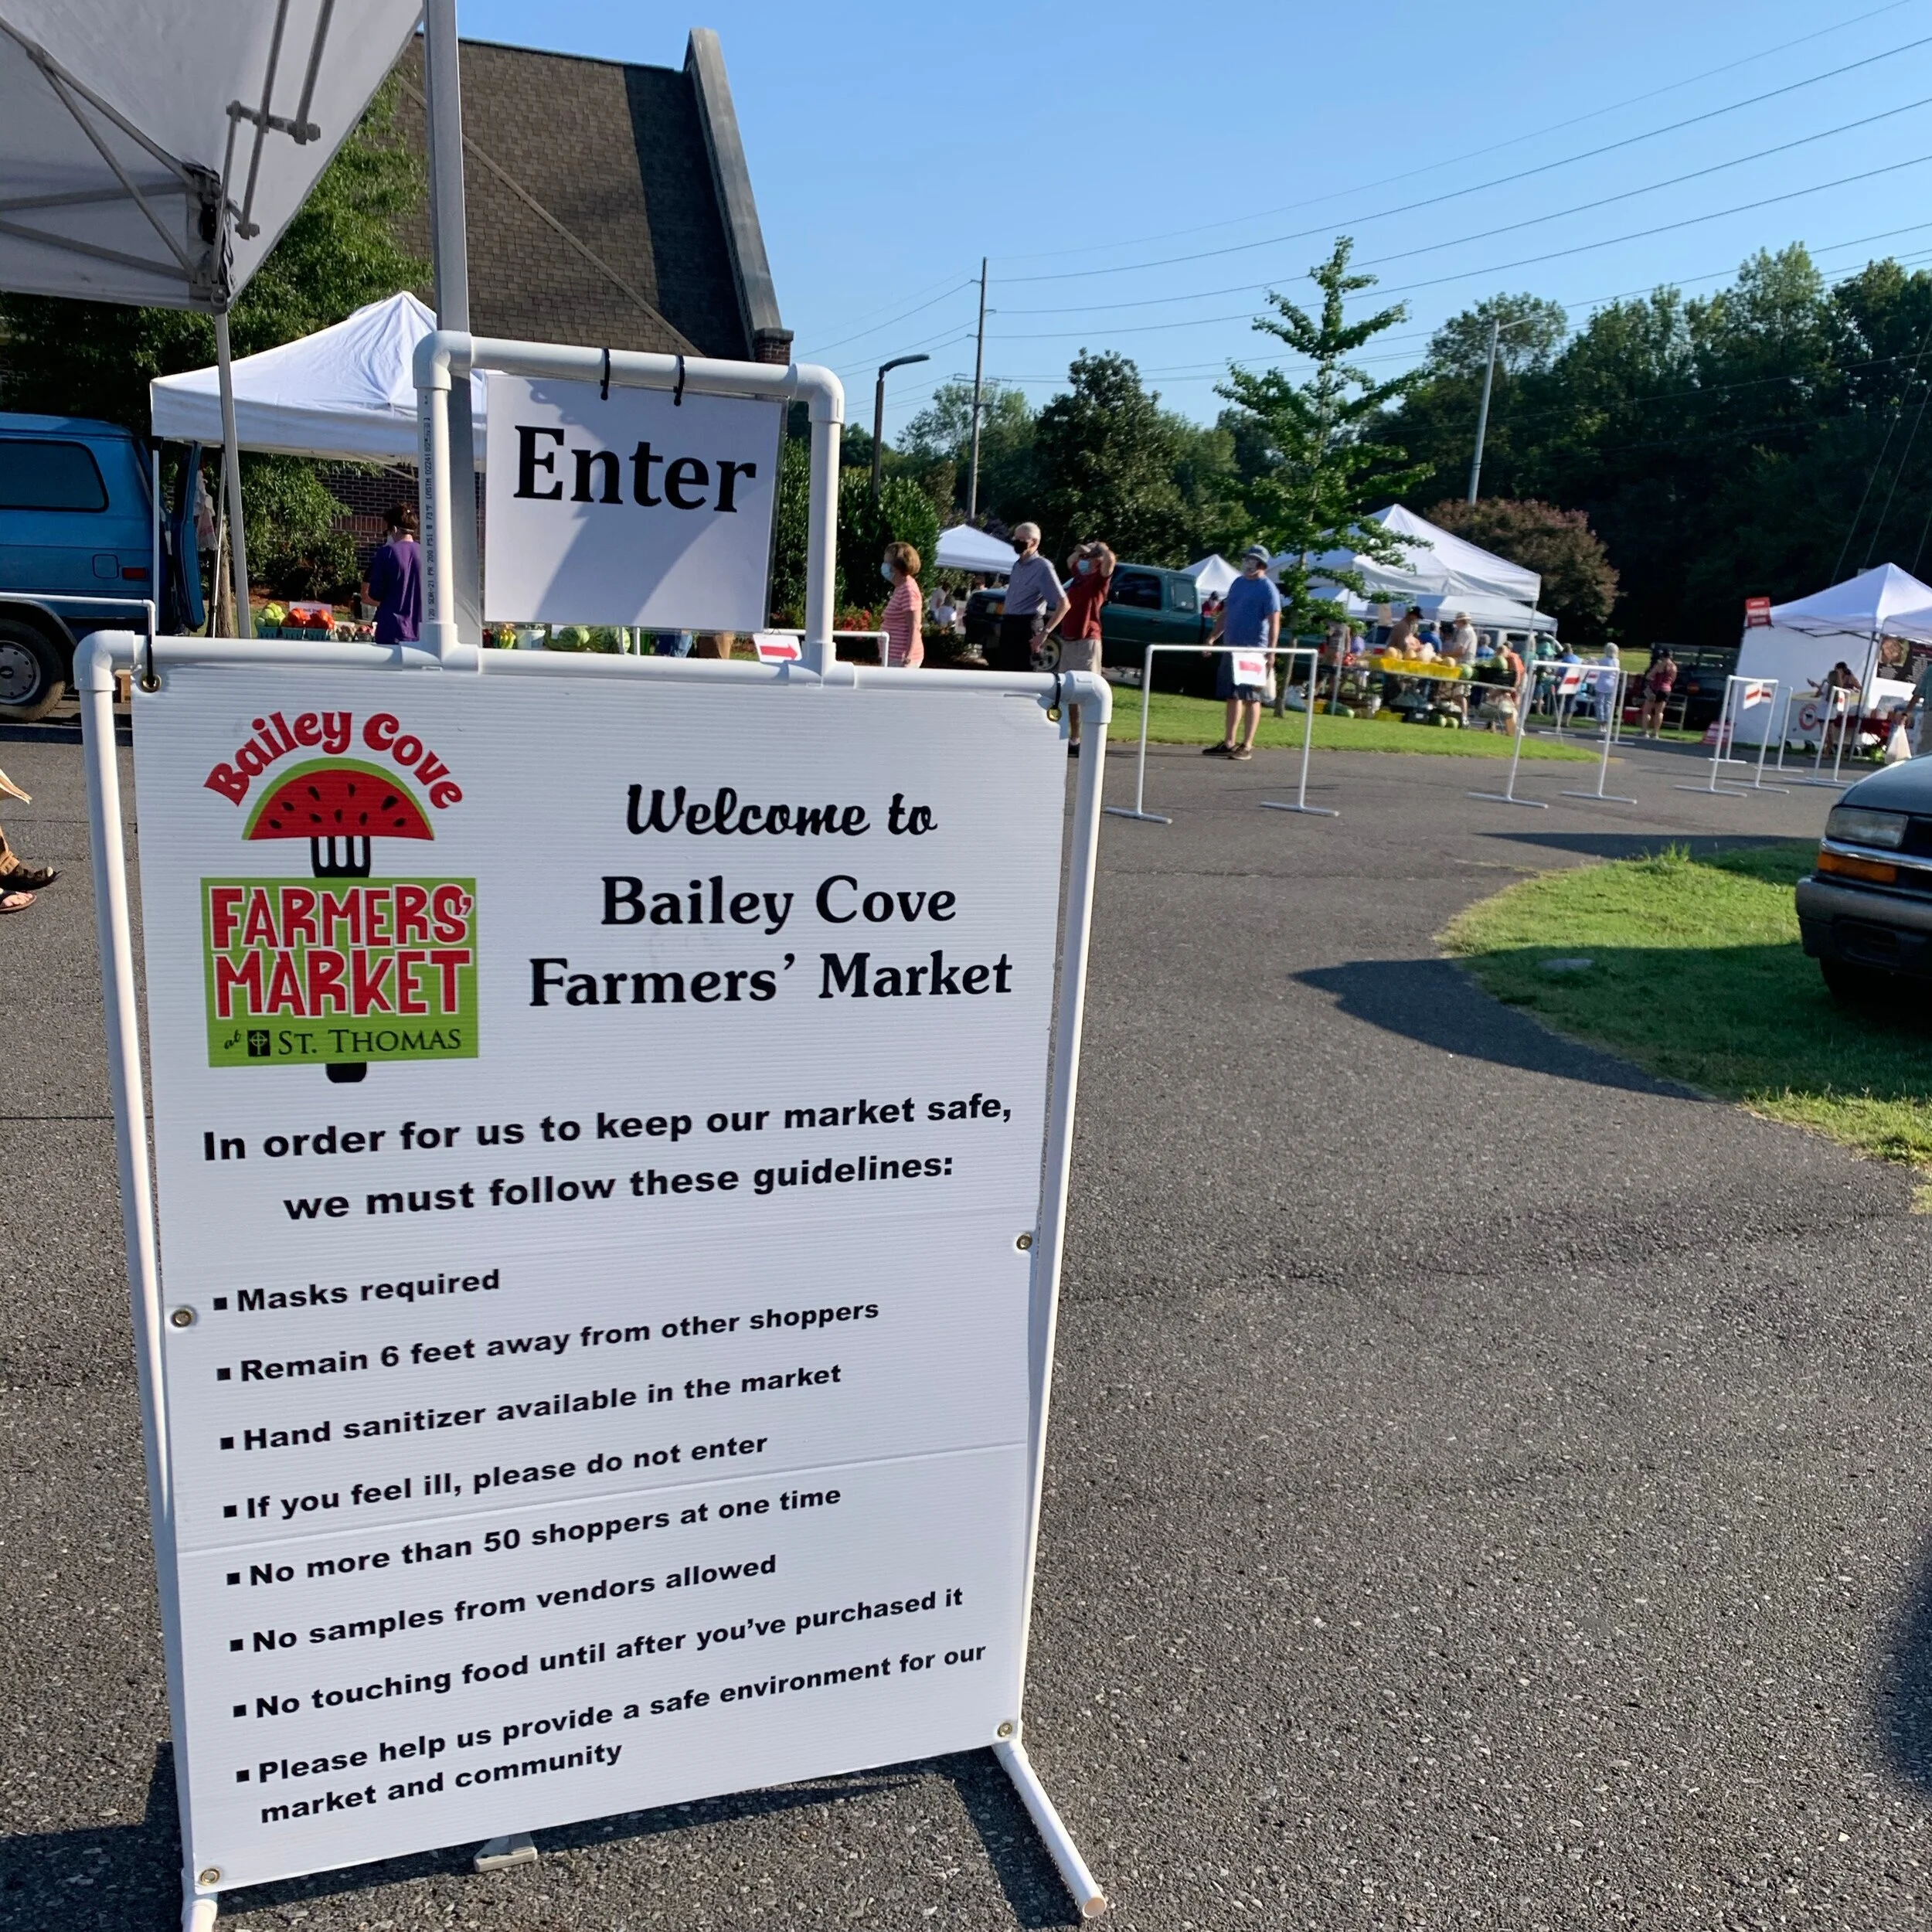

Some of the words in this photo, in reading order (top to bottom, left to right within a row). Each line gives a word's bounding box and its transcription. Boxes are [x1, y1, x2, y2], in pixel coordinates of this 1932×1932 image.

[513, 425, 757, 514] Enter
[203, 711, 352, 807] Bailey
[362, 713, 463, 809] Cove
[626, 784, 871, 837] Welcome
[887, 792, 938, 835] to
[600, 875, 794, 936] Bailey
[815, 874, 956, 923] Cove
[213, 948, 471, 1019] MARKET
[529, 953, 795, 1007] Farmers’
[818, 949, 1013, 999] Market
[223, 1029, 242, 1050] at
[278, 1030, 318, 1056] ST.
[327, 1029, 461, 1053] THOMAS
[203, 1131, 246, 1161] In
[263, 1125, 386, 1158] order
[399, 1121, 461, 1150] for
[477, 1123, 525, 1146] us
[540, 1116, 580, 1142] to
[597, 1112, 692, 1142] keep
[706, 1111, 770, 1133] our
[784, 1097, 915, 1129] market
[927, 1093, 1011, 1123] safe,
[283, 1196, 349, 1220] we
[366, 1182, 474, 1215] must
[488, 1175, 616, 1206] follow
[629, 1168, 739, 1197] these
[753, 1155, 953, 1196] guidelines:
[237, 1284, 348, 1312] Masks
[361, 1268, 499, 1303] required
[240, 1350, 368, 1382] Remain
[380, 1345, 399, 1367] 6
[410, 1338, 475, 1365] feet
[487, 1333, 570, 1357] away
[580, 1325, 650, 1347] from
[662, 1315, 740, 1338] other
[750, 1304, 879, 1330] shoppers
[243, 1420, 331, 1451] Hand
[343, 1407, 486, 1439] sanitizer
[497, 1388, 637, 1421] available
[648, 1383, 673, 1403] in
[684, 1378, 731, 1399] the
[741, 1364, 842, 1393] market
[247, 1495, 270, 1519] If
[281, 1492, 339, 1520] you
[351, 1478, 411, 1505] feel
[424, 1472, 461, 1497] ill,
[474, 1462, 576, 1495] please
[587, 1453, 622, 1475] do
[634, 1444, 681, 1468] not
[691, 1437, 768, 1461] enter
[250, 1563, 294, 1586] No
[307, 1553, 390, 1578] more
[401, 1540, 471, 1564] than
[484, 1529, 520, 1553] 50
[532, 1512, 670, 1546] shoppers
[680, 1503, 709, 1525] at
[719, 1499, 770, 1519] one
[779, 1490, 841, 1511] time
[253, 1629, 298, 1652] No
[309, 1610, 444, 1644] samples
[454, 1597, 526, 1621] from
[536, 1577, 655, 1608] vendors
[665, 1554, 776, 1589] allowed
[256, 1695, 300, 1718] No
[311, 1672, 451, 1709] touching
[461, 1655, 528, 1684] food
[540, 1642, 605, 1672] until
[616, 1634, 686, 1659] after
[696, 1618, 786, 1651] you’ve
[796, 1590, 936, 1635] purchased
[945, 1587, 963, 1607] it
[259, 1751, 368, 1784] Please
[379, 1735, 445, 1762] help
[457, 1730, 492, 1748] us
[503, 1706, 613, 1746] provide
[623, 1704, 639, 1719] a
[650, 1689, 710, 1715] safe
[719, 1658, 891, 1702] environment
[899, 1653, 936, 1673] for
[944, 1646, 986, 1665] our
[261, 1784, 376, 1824] market
[388, 1771, 444, 1801] and
[455, 1744, 622, 1787] community
